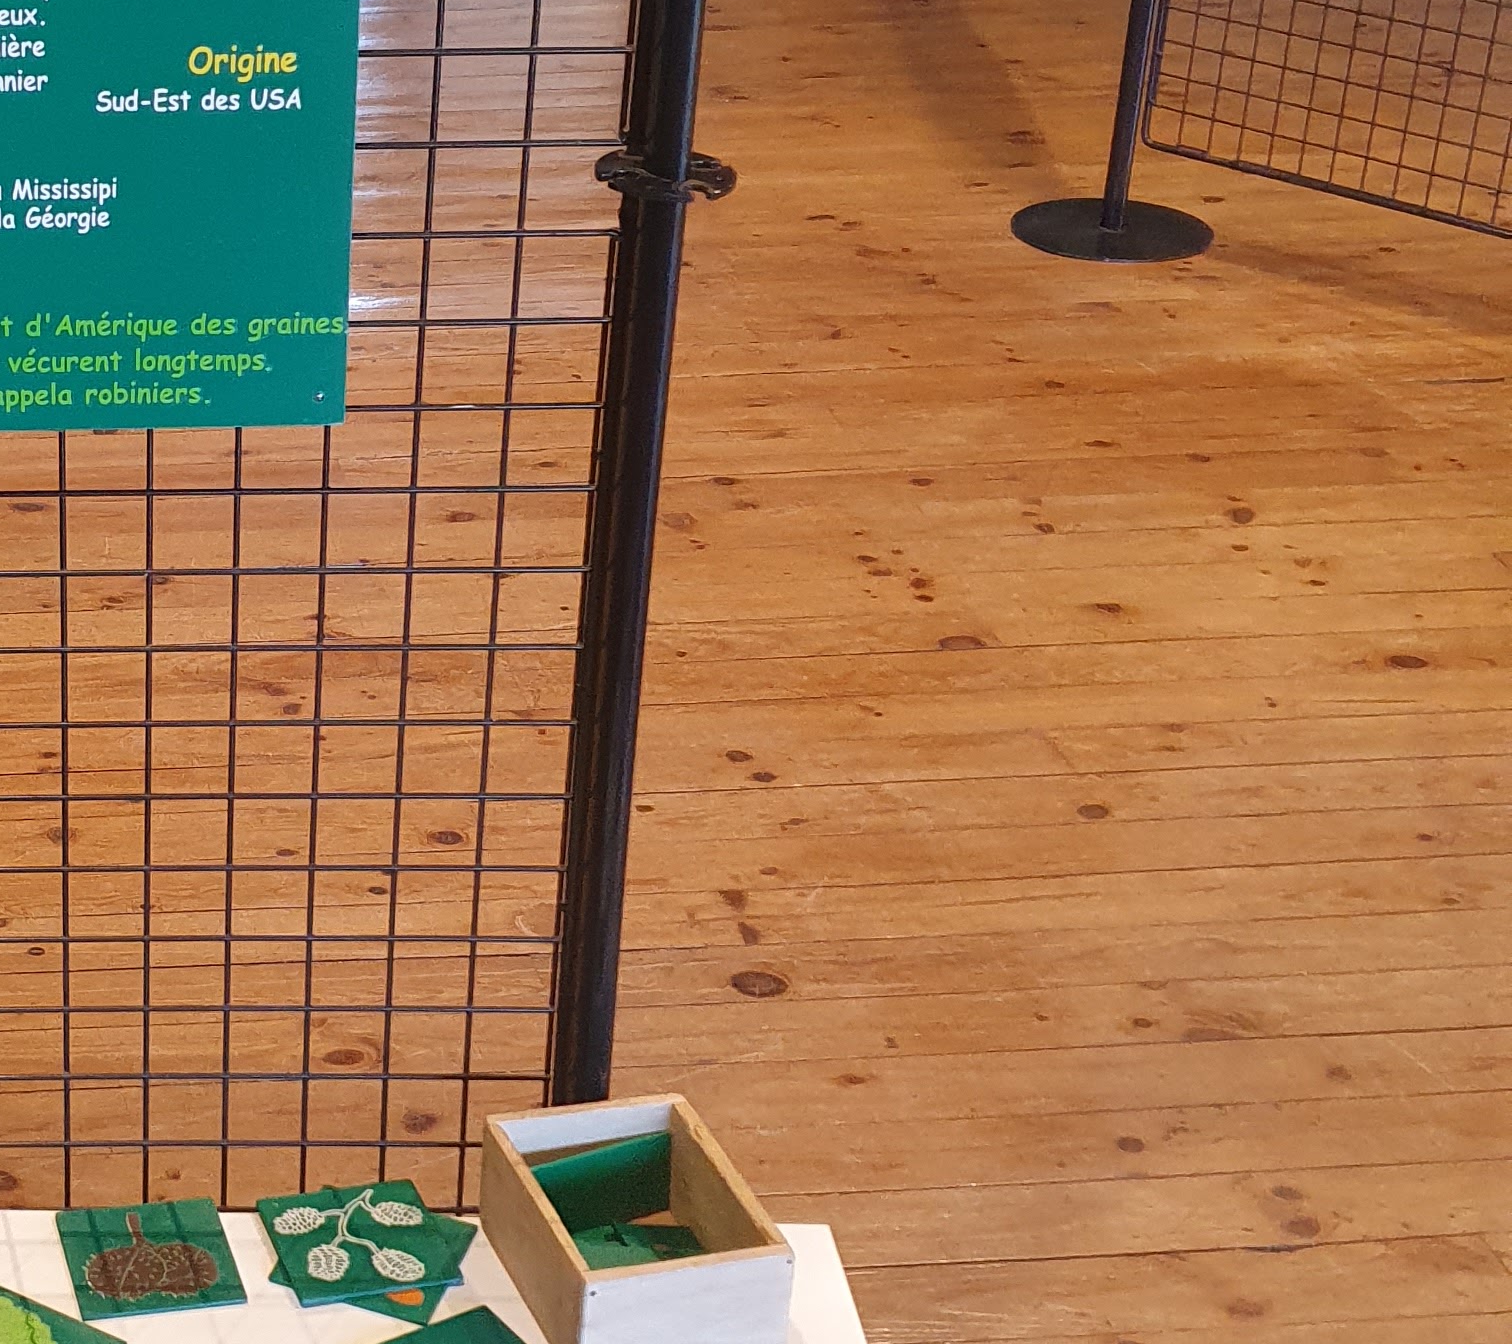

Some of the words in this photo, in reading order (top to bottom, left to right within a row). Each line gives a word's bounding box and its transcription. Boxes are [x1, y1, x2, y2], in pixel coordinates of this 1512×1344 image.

[188, 46, 298, 85] Origine
[95, 90, 191, 113] Sud-Est
[200, 90, 241, 111] des
[249, 89, 303, 111] USA
[12, 177, 118, 203] Mississipi
[25, 206, 111, 234] Géorgie
[190, 313, 236, 336] des
[7, 350, 123, 376] vécurent
[134, 349, 273, 378] longtemps.
[84, 382, 211, 406] robiniers.
